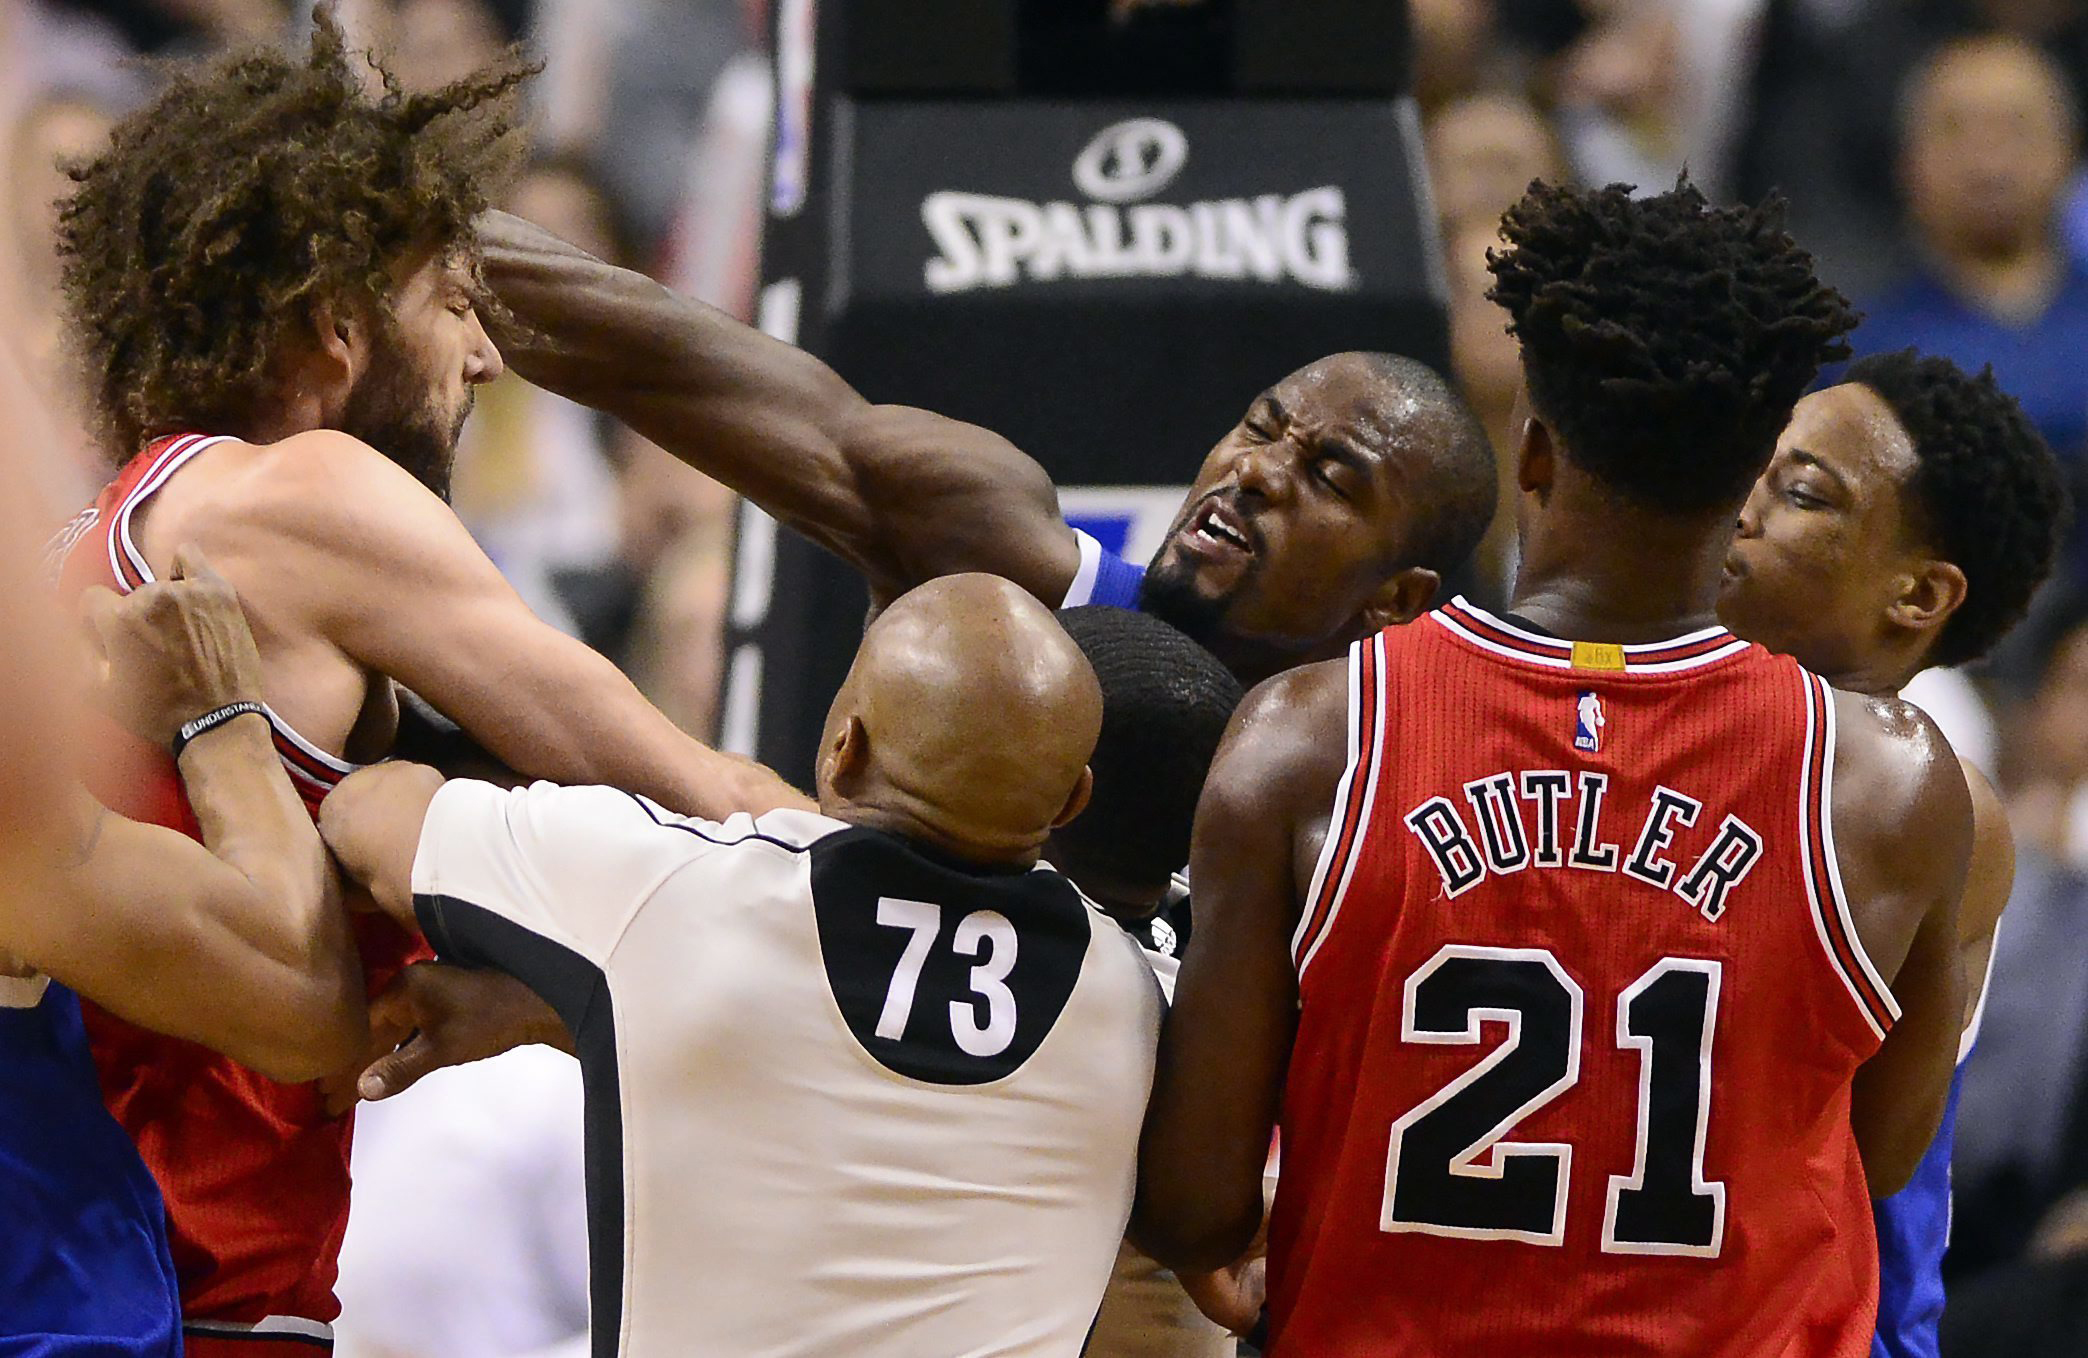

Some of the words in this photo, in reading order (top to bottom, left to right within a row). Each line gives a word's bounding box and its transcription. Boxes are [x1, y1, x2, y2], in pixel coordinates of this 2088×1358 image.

[922, 185, 1351, 293] SPALDING
[1403, 769, 1764, 923] BUTLER
[874, 896, 1018, 1057] 73
[1380, 944, 1726, 1258] 21
